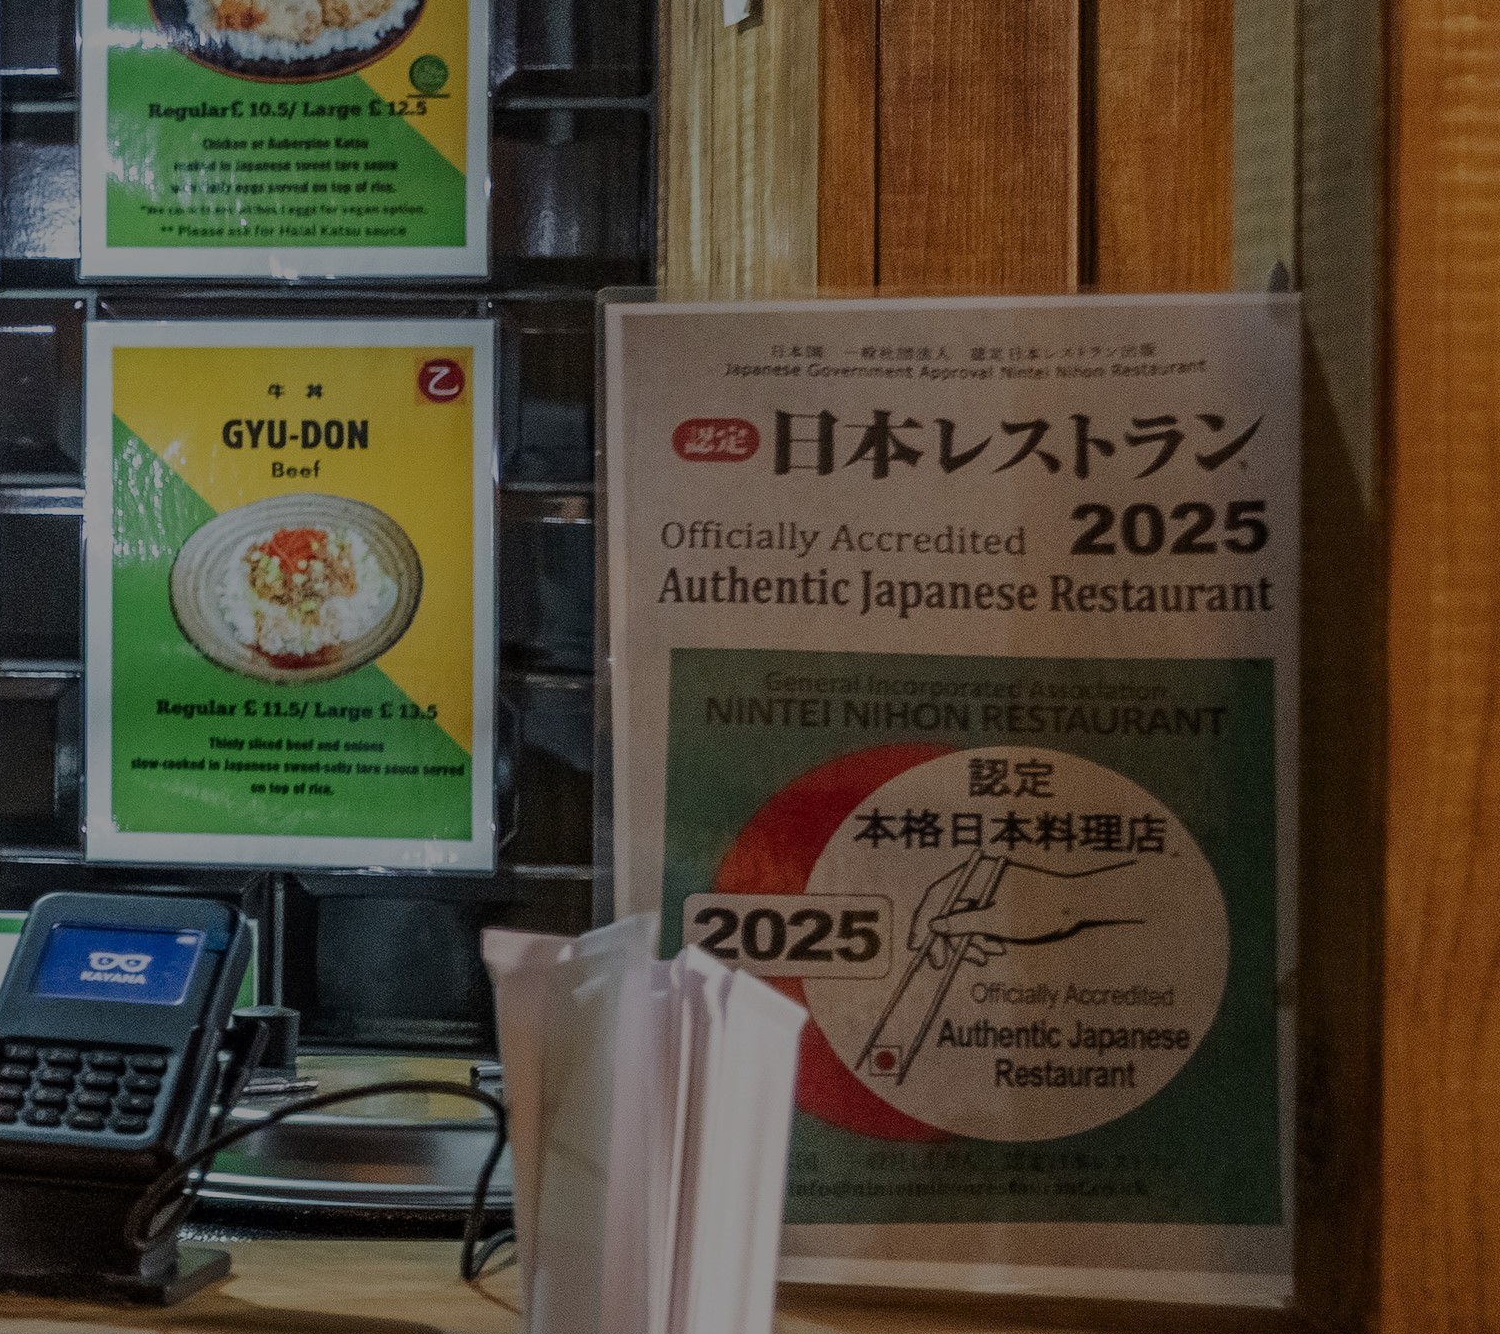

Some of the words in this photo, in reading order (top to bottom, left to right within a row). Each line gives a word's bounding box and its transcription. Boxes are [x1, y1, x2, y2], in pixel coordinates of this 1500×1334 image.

[302, 101, 362, 120] Large
[368, 100, 382, 117] £
[387, 101, 427, 117] 12.5
[724, 364, 801, 377] Japanese
[807, 364, 913, 377] Government
[919, 365, 993, 380] Approval
[1111, 360, 1208, 378] Restaurant
[268, 383, 323, 399] 牛丼
[222, 419, 369, 450] GYU-DON
[773, 409, 1265, 480] 日本レストラン
[271, 460, 320, 479] Beef
[660, 521, 821, 558] Officially
[830, 523, 1026, 556] Accredited
[1070, 500, 1270, 556] 2025
[657, 568, 849, 605] Authentic
[859, 570, 1037, 617] Japanese
[1049, 575, 1274, 612] Restaurant
[767, 672, 859, 695] General
[866, 675, 1021, 699] Incorporated
[1028, 681, 1167, 700] Association
[156, 700, 236, 718] Regular
[244, 700, 256, 716] £
[314, 703, 373, 722] Large
[380, 702, 392, 719] £
[706, 697, 831, 727] NINTEI
[843, 701, 970, 731] NIHON
[981, 705, 1227, 736] RESTAURANT
[209, 738, 244, 750] Thinly
[248, 738, 282, 751] sliced
[286, 739, 313, 751] beef
[318, 740, 339, 752] and
[344, 741, 384, 752] onions
[224, 760, 280, 773] Japanese
[384, 764, 419, 775] sauce
[423, 764, 464, 776] served
[968, 759, 1054, 798] 認定
[251, 784, 266, 793] on
[270, 783, 289, 795] top
[294, 783, 305, 794] of
[853, 810, 1167, 854] 本格日本料理店
[694, 907, 881, 962] 2025
[970, 982, 1057, 1007] Officially
[1064, 985, 1174, 1007] Accredited
[937, 1018, 1060, 1049] Authentic
[1067, 1022, 1191, 1051] Japanese
[994, 1059, 1137, 1089] Restaurant
